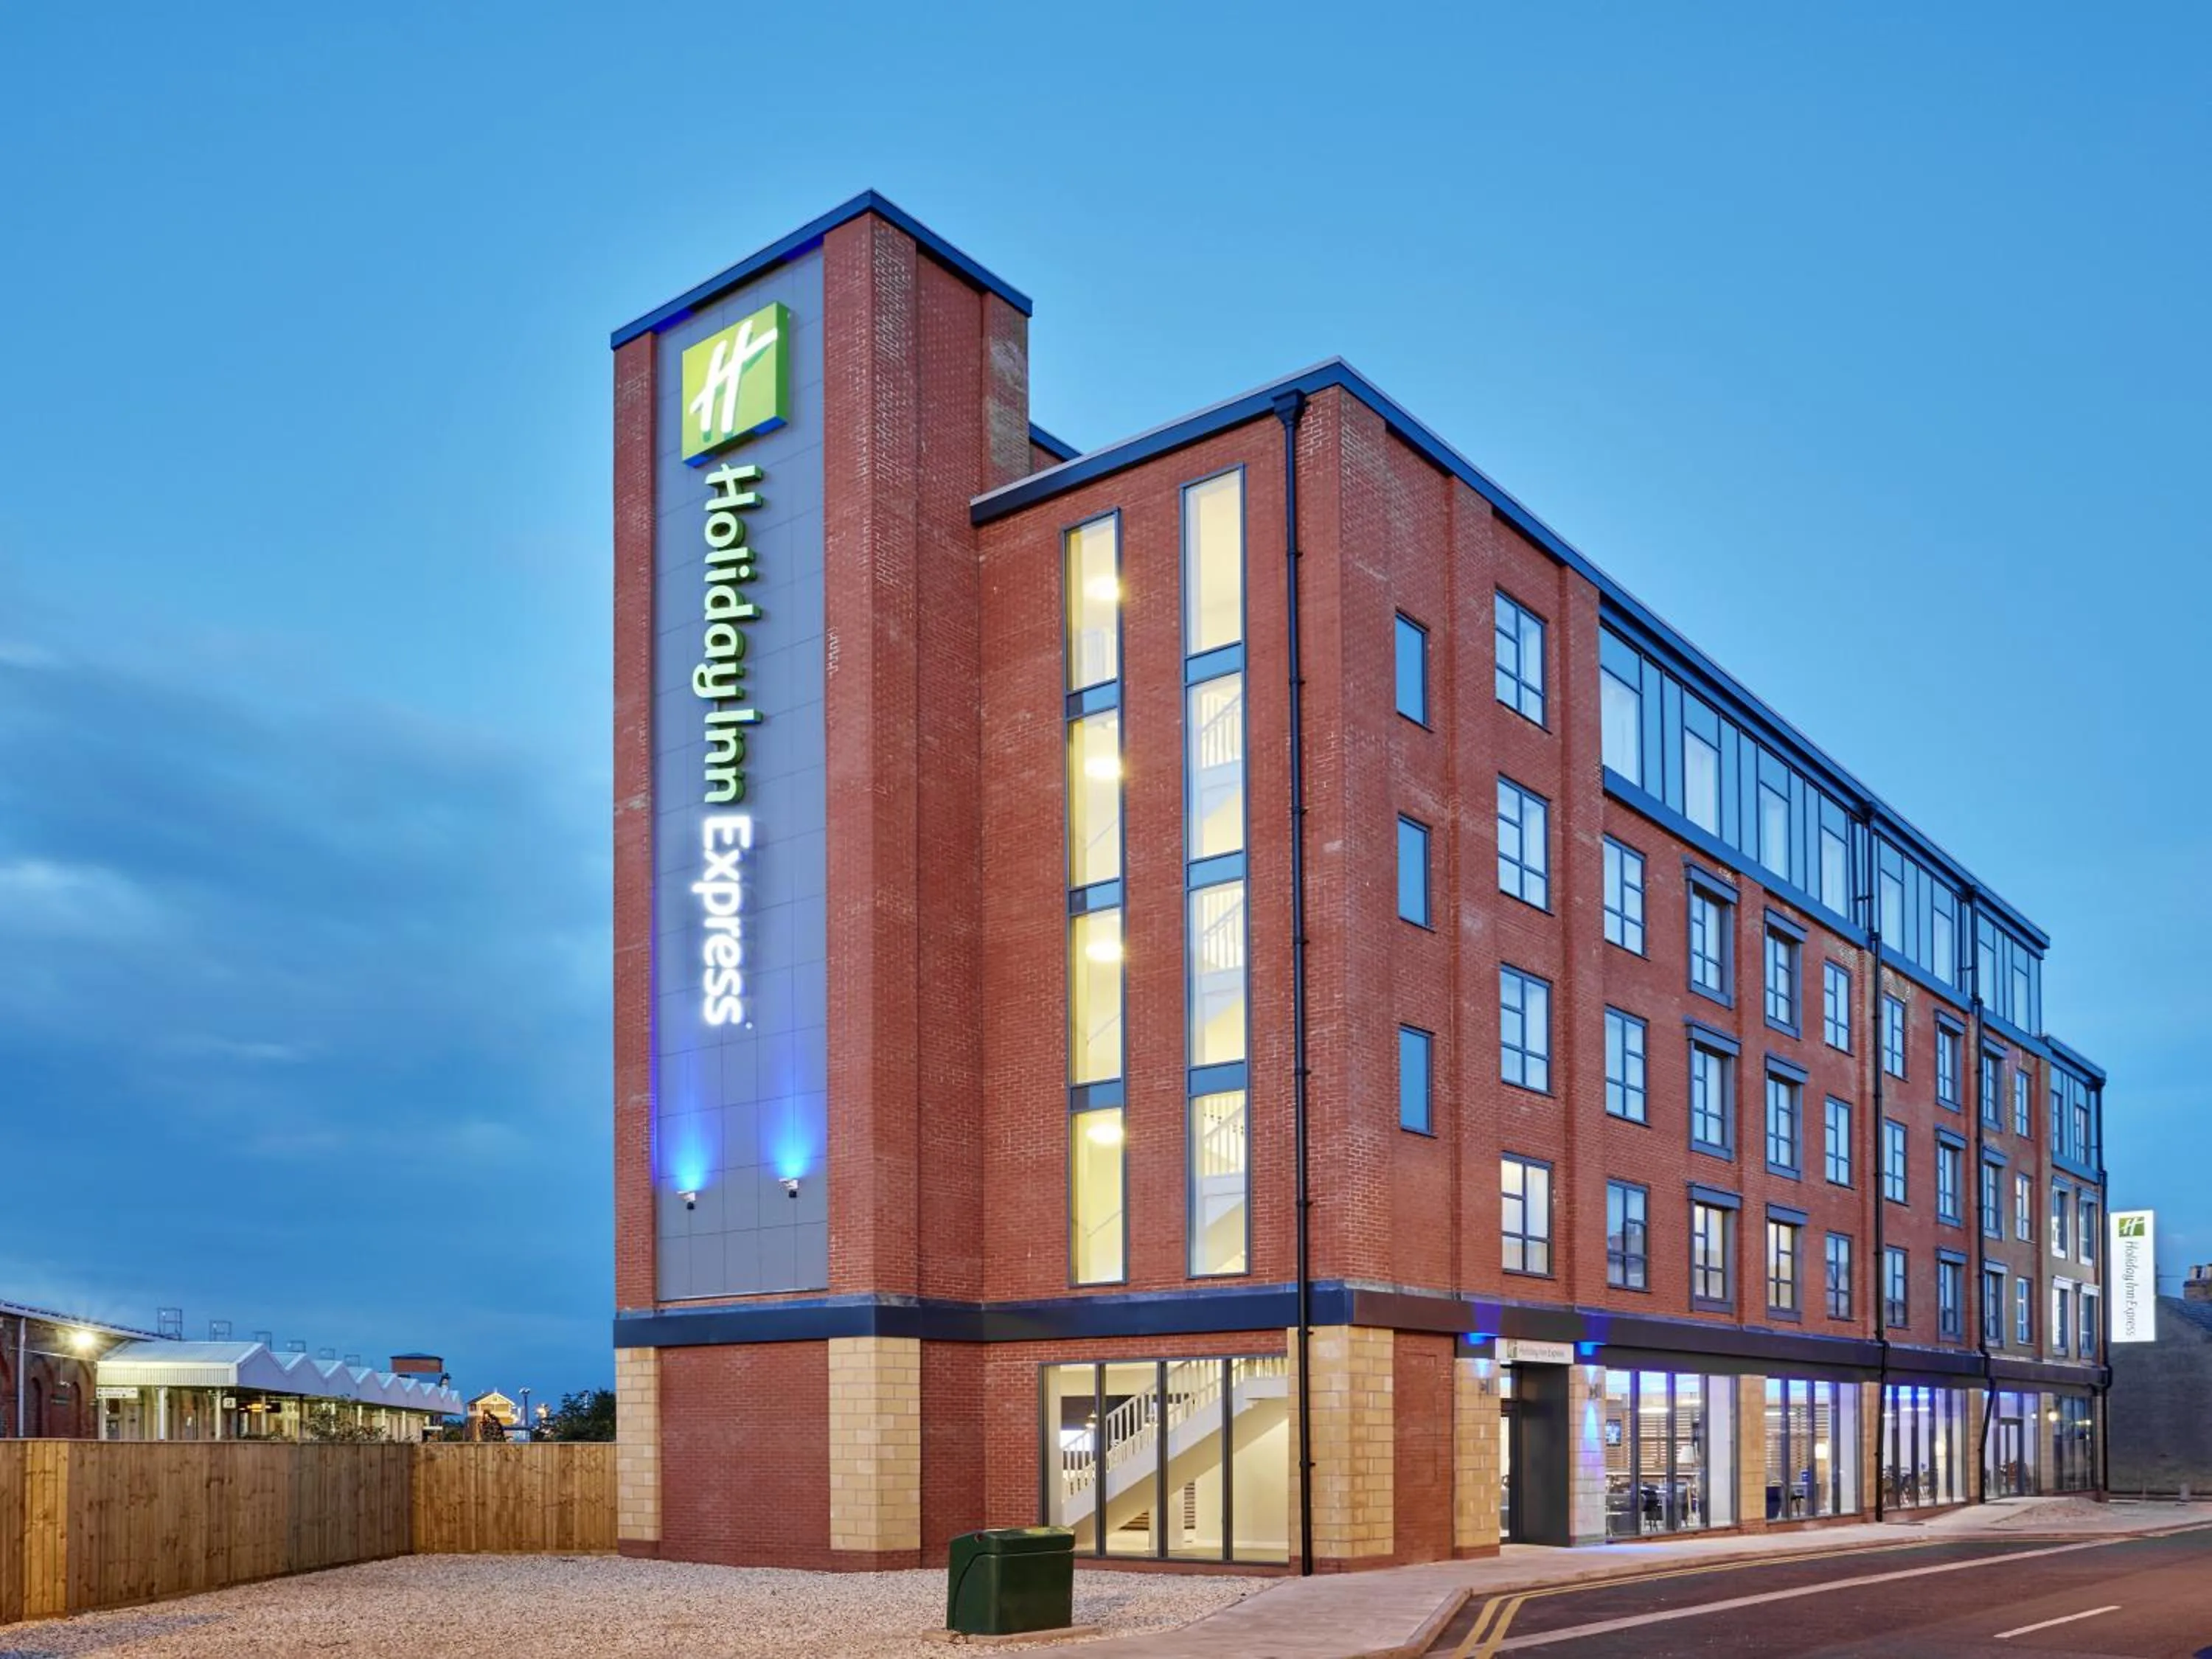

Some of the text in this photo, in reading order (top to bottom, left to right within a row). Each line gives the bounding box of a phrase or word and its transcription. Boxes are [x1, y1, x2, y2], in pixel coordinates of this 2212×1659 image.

[691, 463, 760, 1026] Holiday Inn Express
